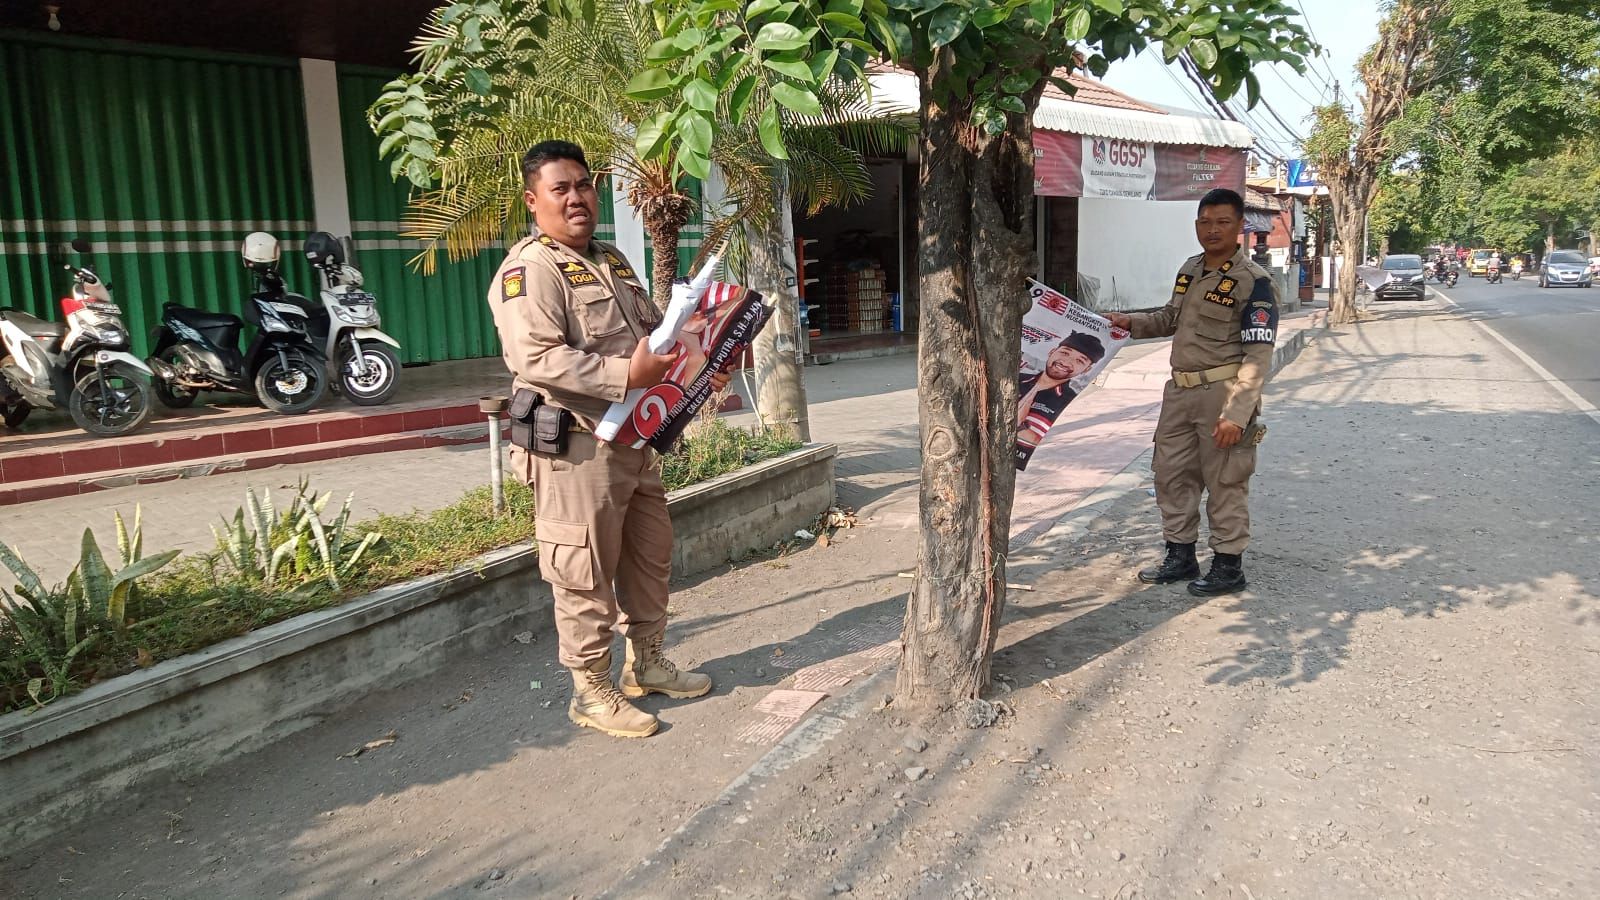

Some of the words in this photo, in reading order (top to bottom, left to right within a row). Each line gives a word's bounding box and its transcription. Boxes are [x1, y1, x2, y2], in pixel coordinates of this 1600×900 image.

[1109, 140, 1147, 168] GGSP
[1192, 173, 1215, 181] FILTER
[568, 274, 595, 284] YOGA
[1032, 288, 1043, 298] 9
[1206, 292, 1221, 303] POL
[1221, 297, 1234, 306] PP
[1065, 311, 1100, 334] NUSANTARA
[667, 395, 690, 419] INDRA
[685, 359, 721, 400] MANDHALA
[686, 393, 705, 414] CALEG
